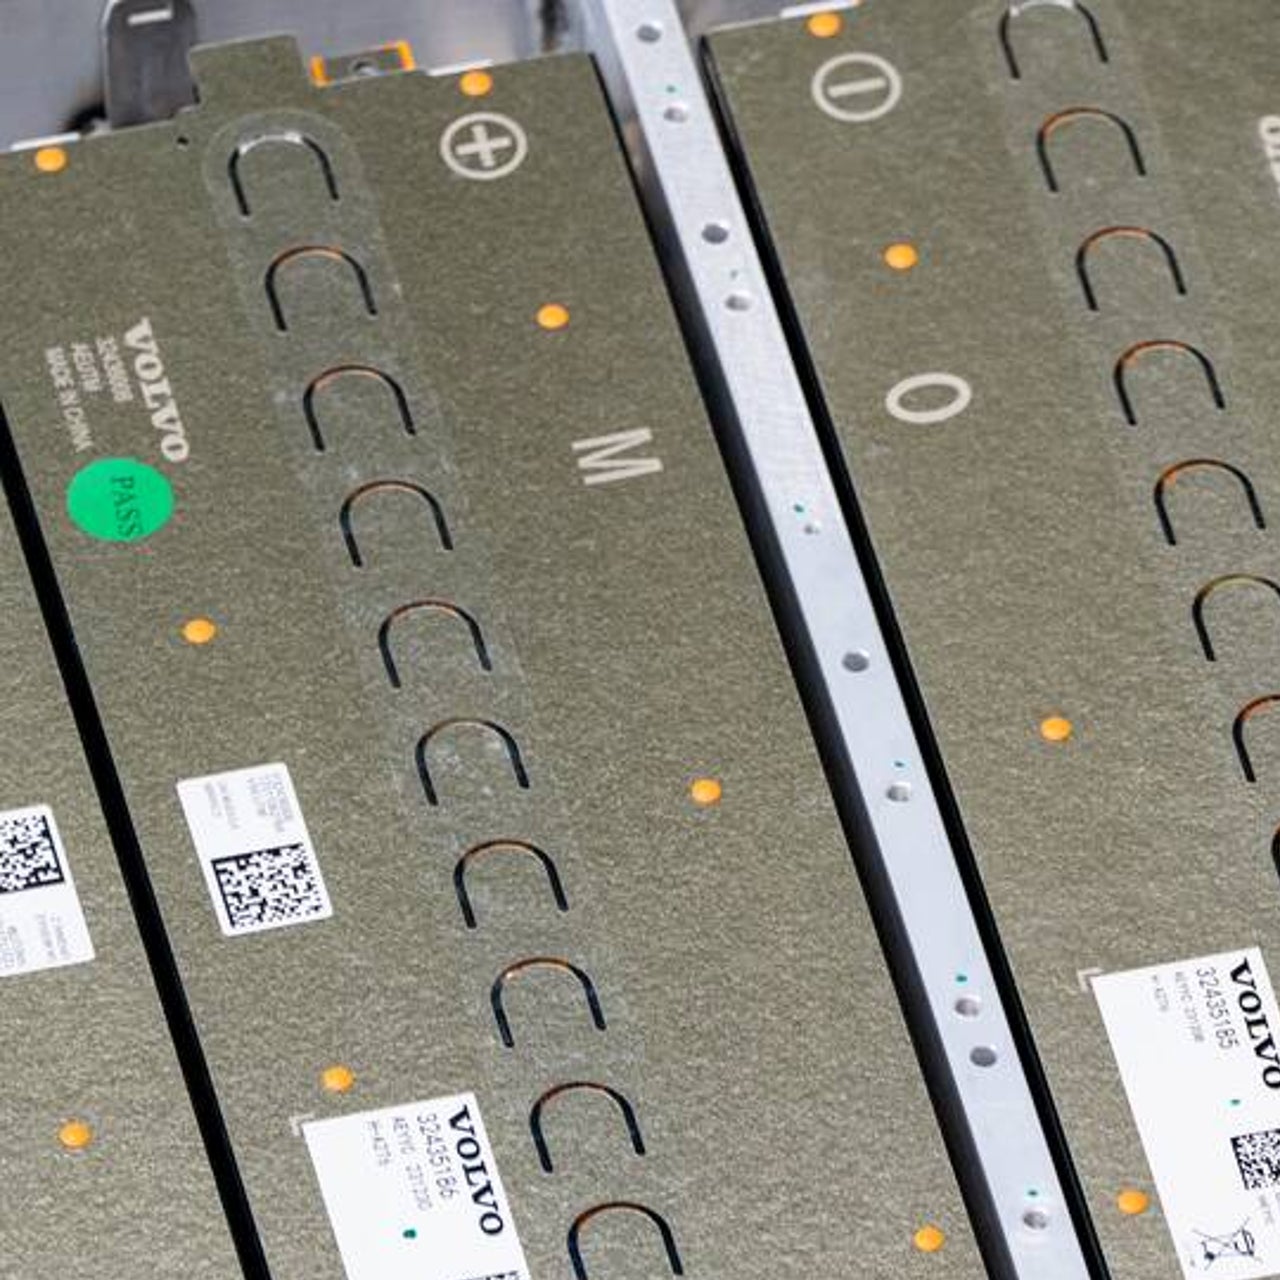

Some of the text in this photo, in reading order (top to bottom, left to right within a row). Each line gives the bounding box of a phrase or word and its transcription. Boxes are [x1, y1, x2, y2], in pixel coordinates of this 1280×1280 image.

[124, 317, 190, 463] VOLVO
[571, 426, 664, 486] M
[110, 474, 144, 538] PASS
[1196, 966, 1240, 1050] 32435185
[448, 1104, 504, 1236] VOLVO
